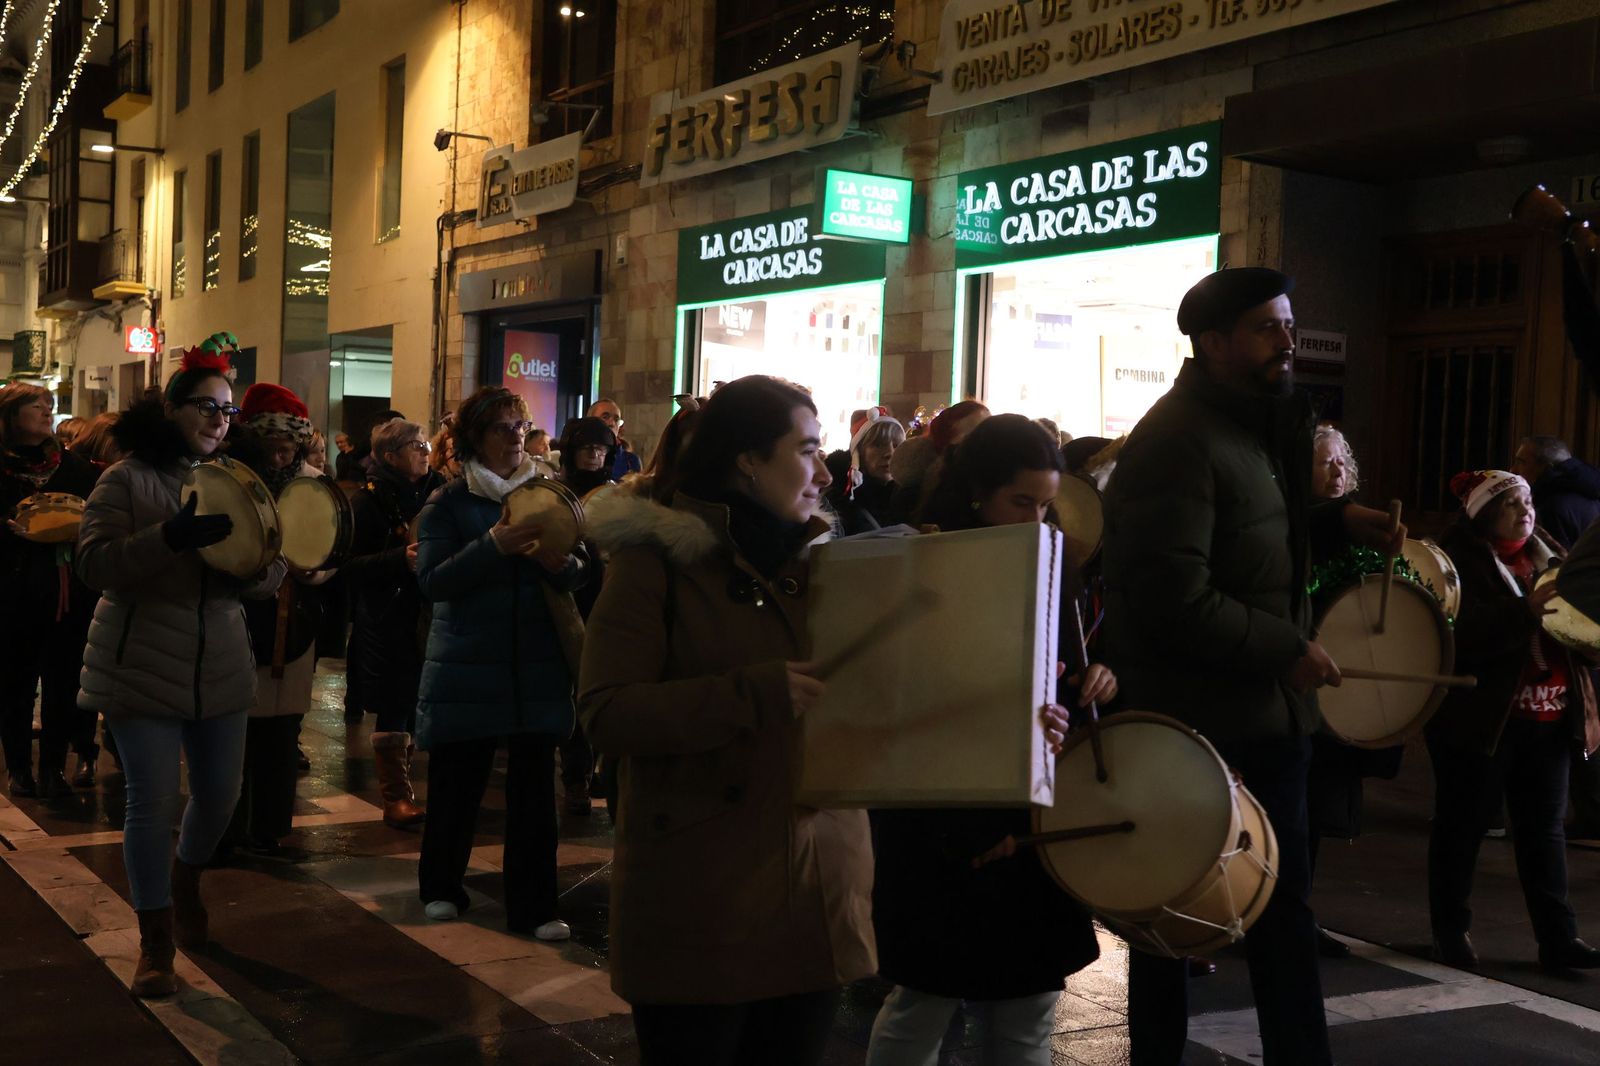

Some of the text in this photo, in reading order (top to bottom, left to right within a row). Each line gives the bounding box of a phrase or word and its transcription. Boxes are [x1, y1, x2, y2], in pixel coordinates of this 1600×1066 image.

[956, 0, 1073, 50] VENTA DE
[953, 39, 1050, 93] GARAJES
[1067, 2, 1183, 65] SOLARES
[648, 60, 842, 177] FERFESA
[837, 180, 899, 202] LA CASA
[964, 141, 1209, 215] LA CASA DE LAS
[830, 212, 903, 233] CARCASAS
[841, 198, 893, 217] DE LAS
[1000, 193, 1158, 245] CARCASAS
[700, 217, 808, 260] LA CASA DE
[723, 248, 823, 285] CARCASAS
[719, 304, 753, 331] NEW
[1300, 337, 1342, 353] FERFESA
[1115, 368, 1166, 384] COMBINA
